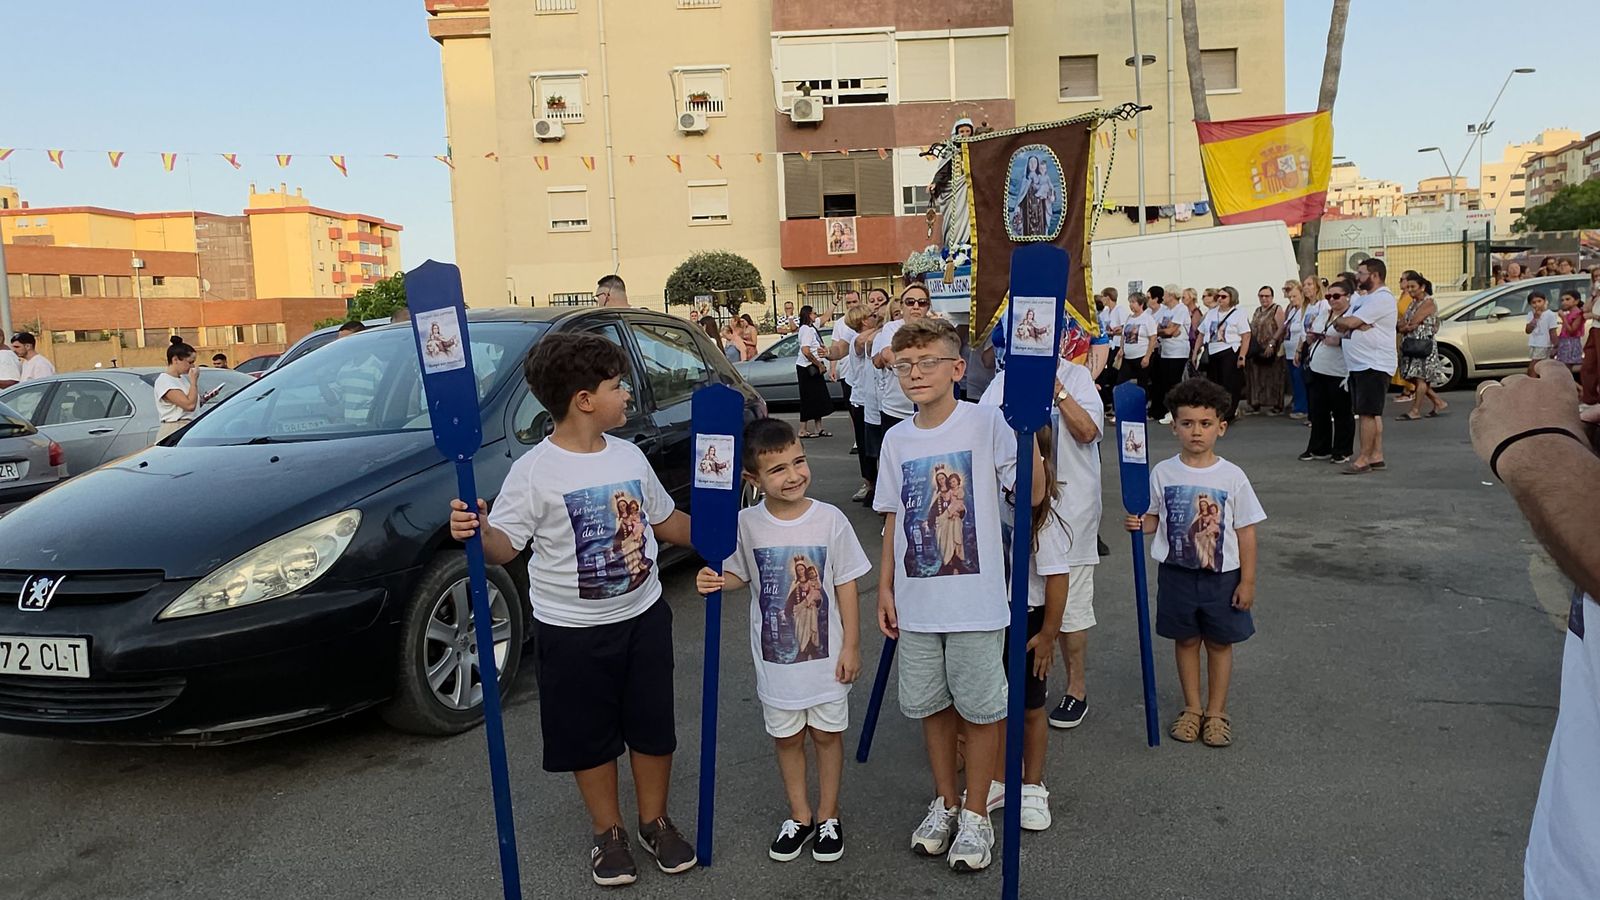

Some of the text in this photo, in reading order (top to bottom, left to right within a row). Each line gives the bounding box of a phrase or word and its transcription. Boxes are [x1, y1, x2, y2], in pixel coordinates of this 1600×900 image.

[582, 527, 595, 538] de
[0, 642, 80, 672] 72 CLT
